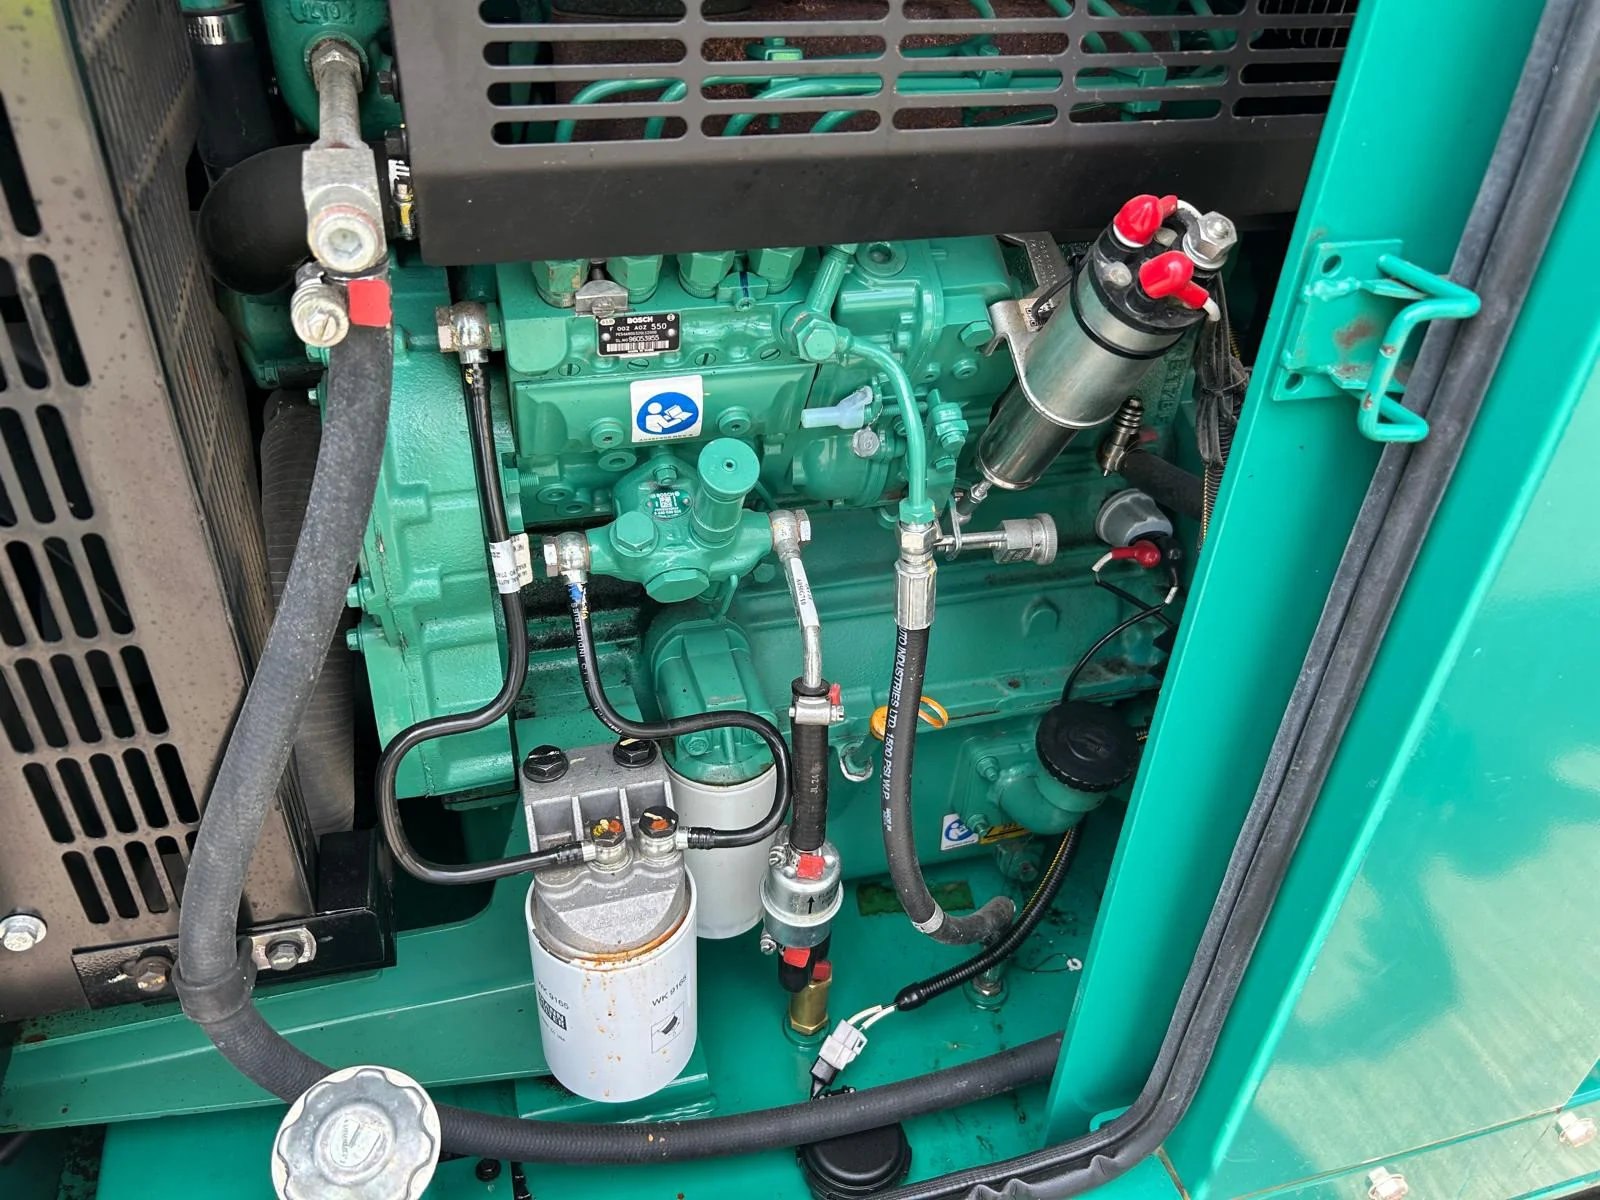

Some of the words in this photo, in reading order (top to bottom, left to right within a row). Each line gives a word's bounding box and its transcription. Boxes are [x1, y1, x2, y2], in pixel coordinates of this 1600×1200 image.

[626, 316, 654, 325] BOSCH
[651, 322, 667, 330] 550
[570, 602, 586, 658] INDUSTRIES
[898, 626, 908, 646] UTO
[890, 645, 907, 708] INDUSTRIES
[884, 733, 895, 758] 1500
[882, 758, 892, 778] PSI
[548, 992, 570, 1010] 9165
[651, 991, 669, 1007] WK
